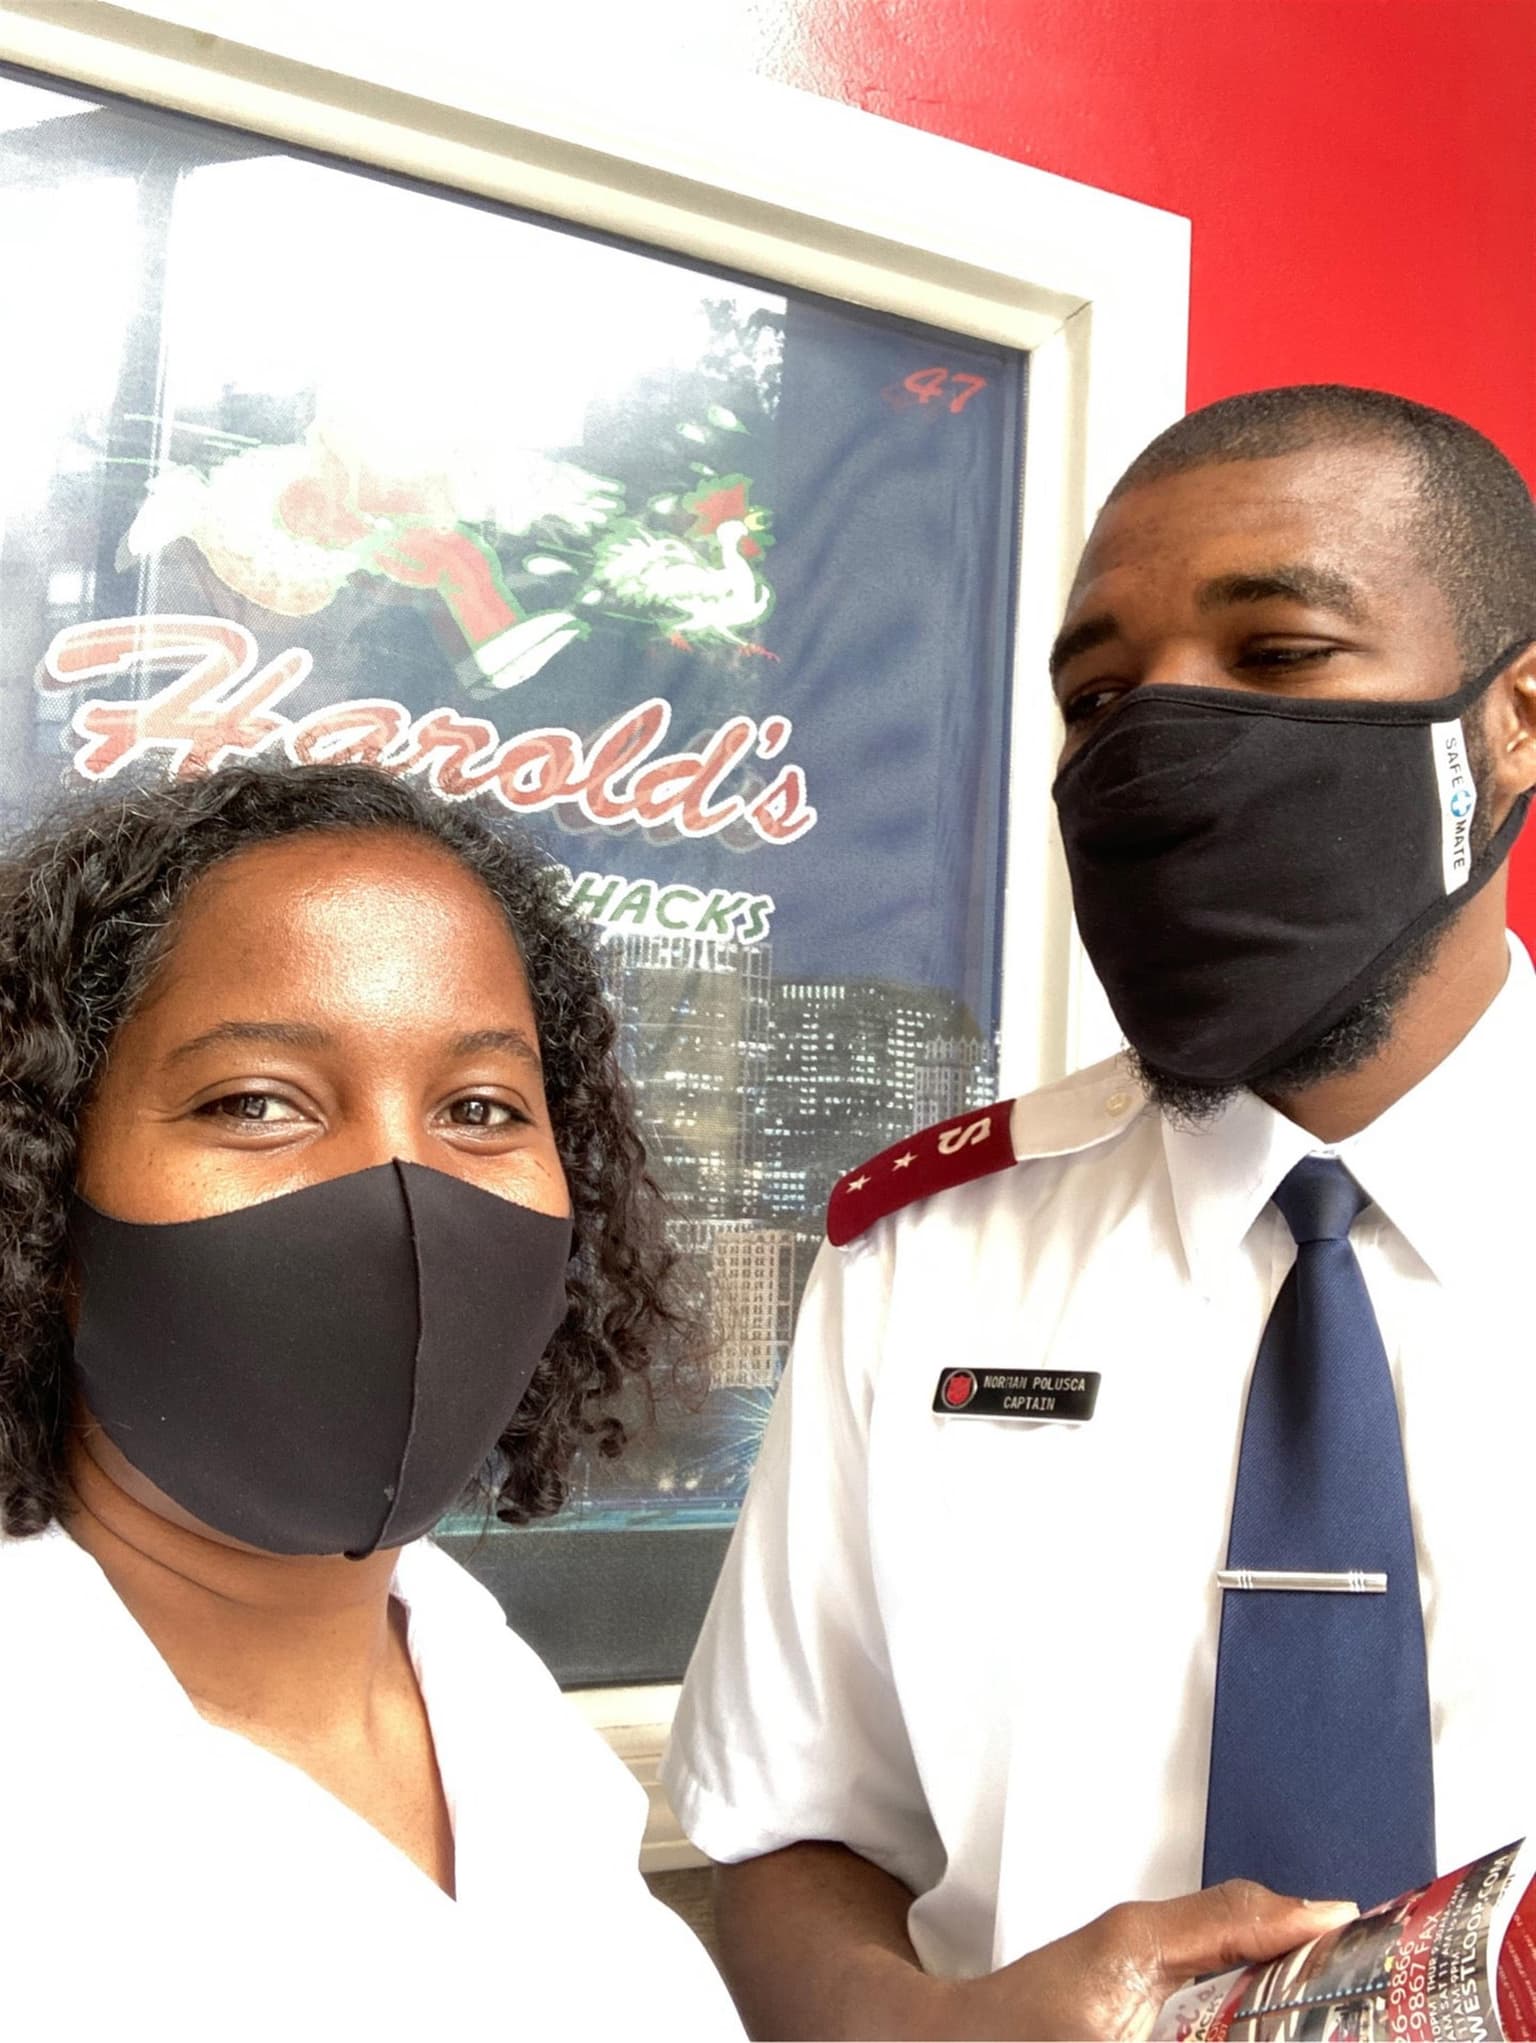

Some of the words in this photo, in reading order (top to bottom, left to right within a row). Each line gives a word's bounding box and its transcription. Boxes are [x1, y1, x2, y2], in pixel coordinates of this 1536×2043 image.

[904, 367, 987, 414] 47
[48, 614, 817, 843] Harold's
[1445, 737, 1464, 788] SAFE
[1453, 818, 1467, 870] MATE
[938, 1117, 992, 1155] S
[984, 1375, 1027, 1389] NORMAN
[1032, 1377, 1085, 1392] POLUSCA
[1003, 1396, 1055, 1410] CAPTAIN
[1414, 1911, 1442, 1955] FAX
[1439, 1983, 1450, 2010] SAT
